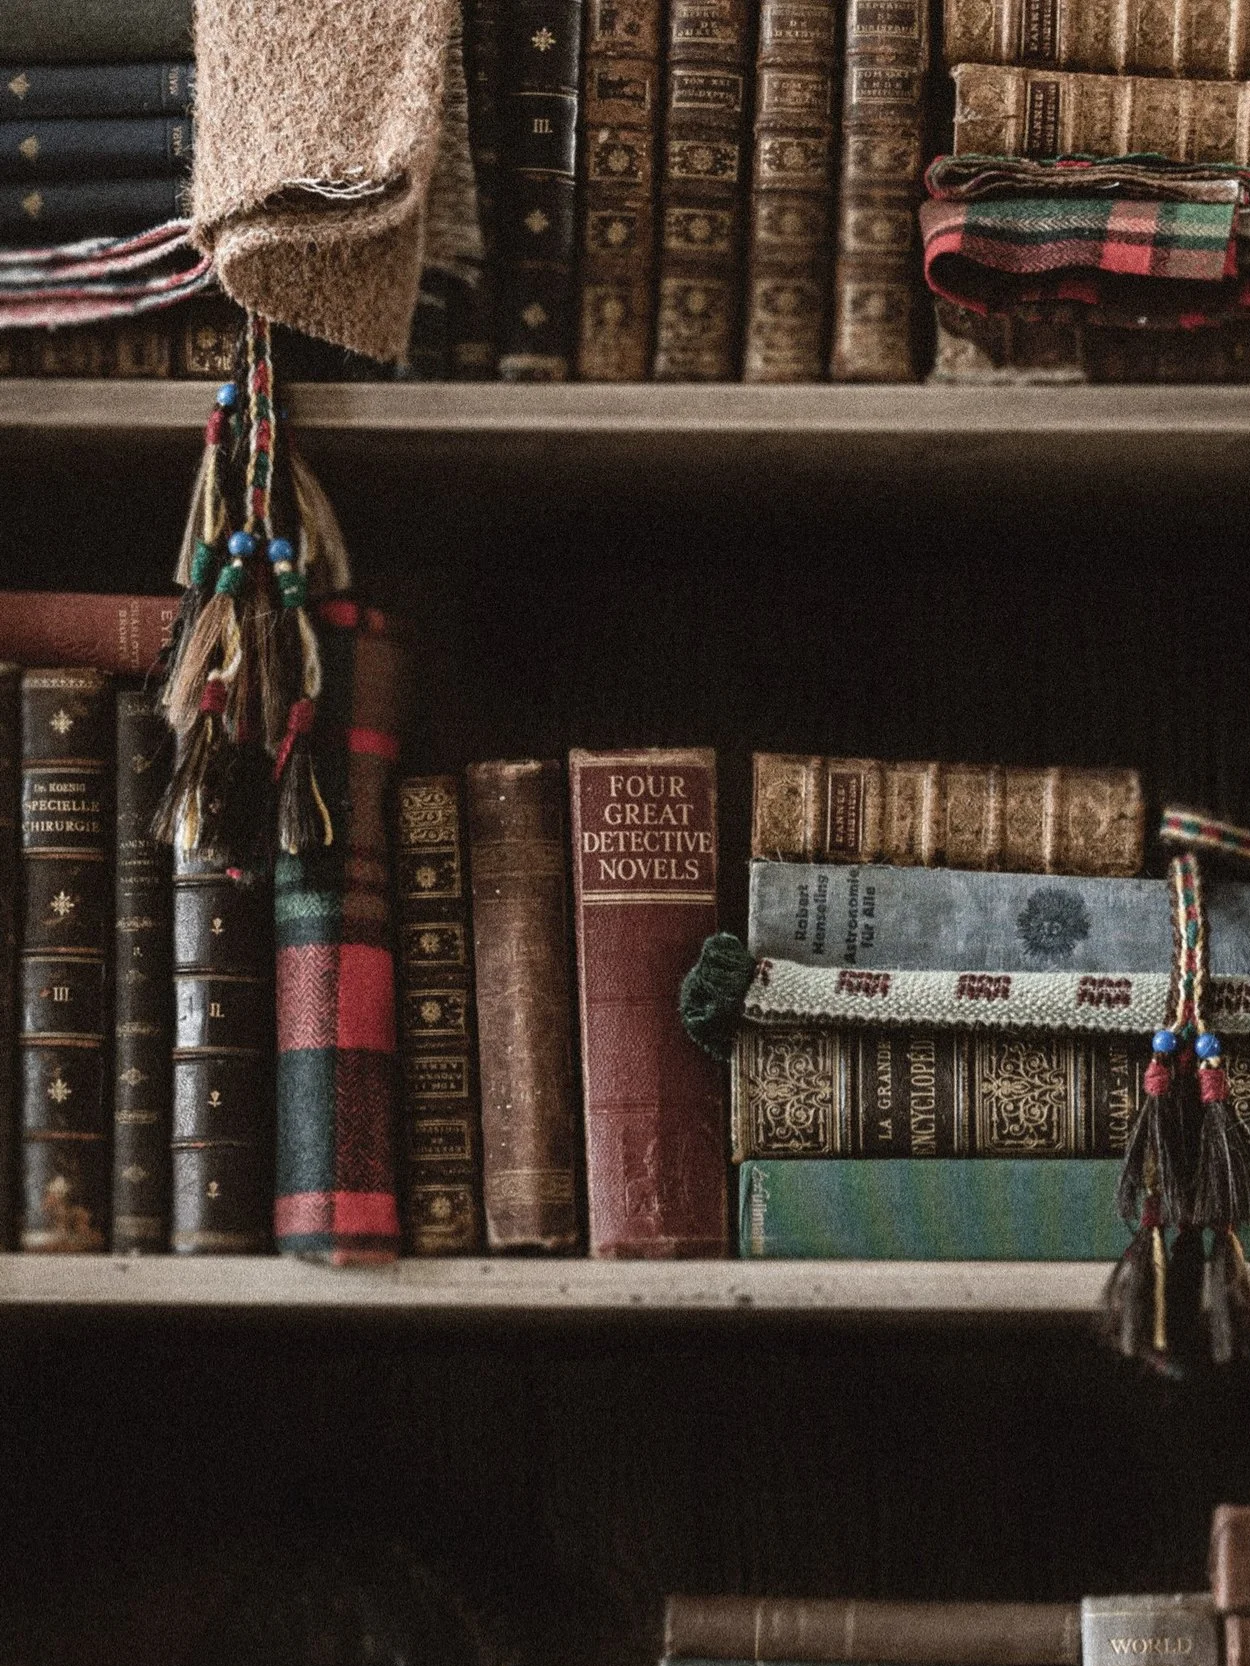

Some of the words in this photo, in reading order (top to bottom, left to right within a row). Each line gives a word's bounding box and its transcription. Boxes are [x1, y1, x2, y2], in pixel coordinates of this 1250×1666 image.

[533, 118, 554, 134] III.
[161, 609, 173, 649] EYR
[49, 783, 87, 793] KOENIG
[610, 775, 687, 798] FOUR
[24, 799, 101, 813] SPECIELLE
[603, 802, 695, 826] GREAT
[22, 819, 101, 833] CHIRURGIE
[583, 831, 714, 854] DETECTIVE
[598, 858, 700, 882] NOVELS
[795, 885, 809, 941] Robert
[861, 886, 876, 918] Alle
[812, 874, 830, 956] Henseling
[844, 868, 860, 964] Astronomie
[861, 922, 875, 949] für
[877, 1040, 893, 1110] GRANDE
[878, 1118, 893, 1141] LA
[1109, 1637, 1193, 1655] WORLD
